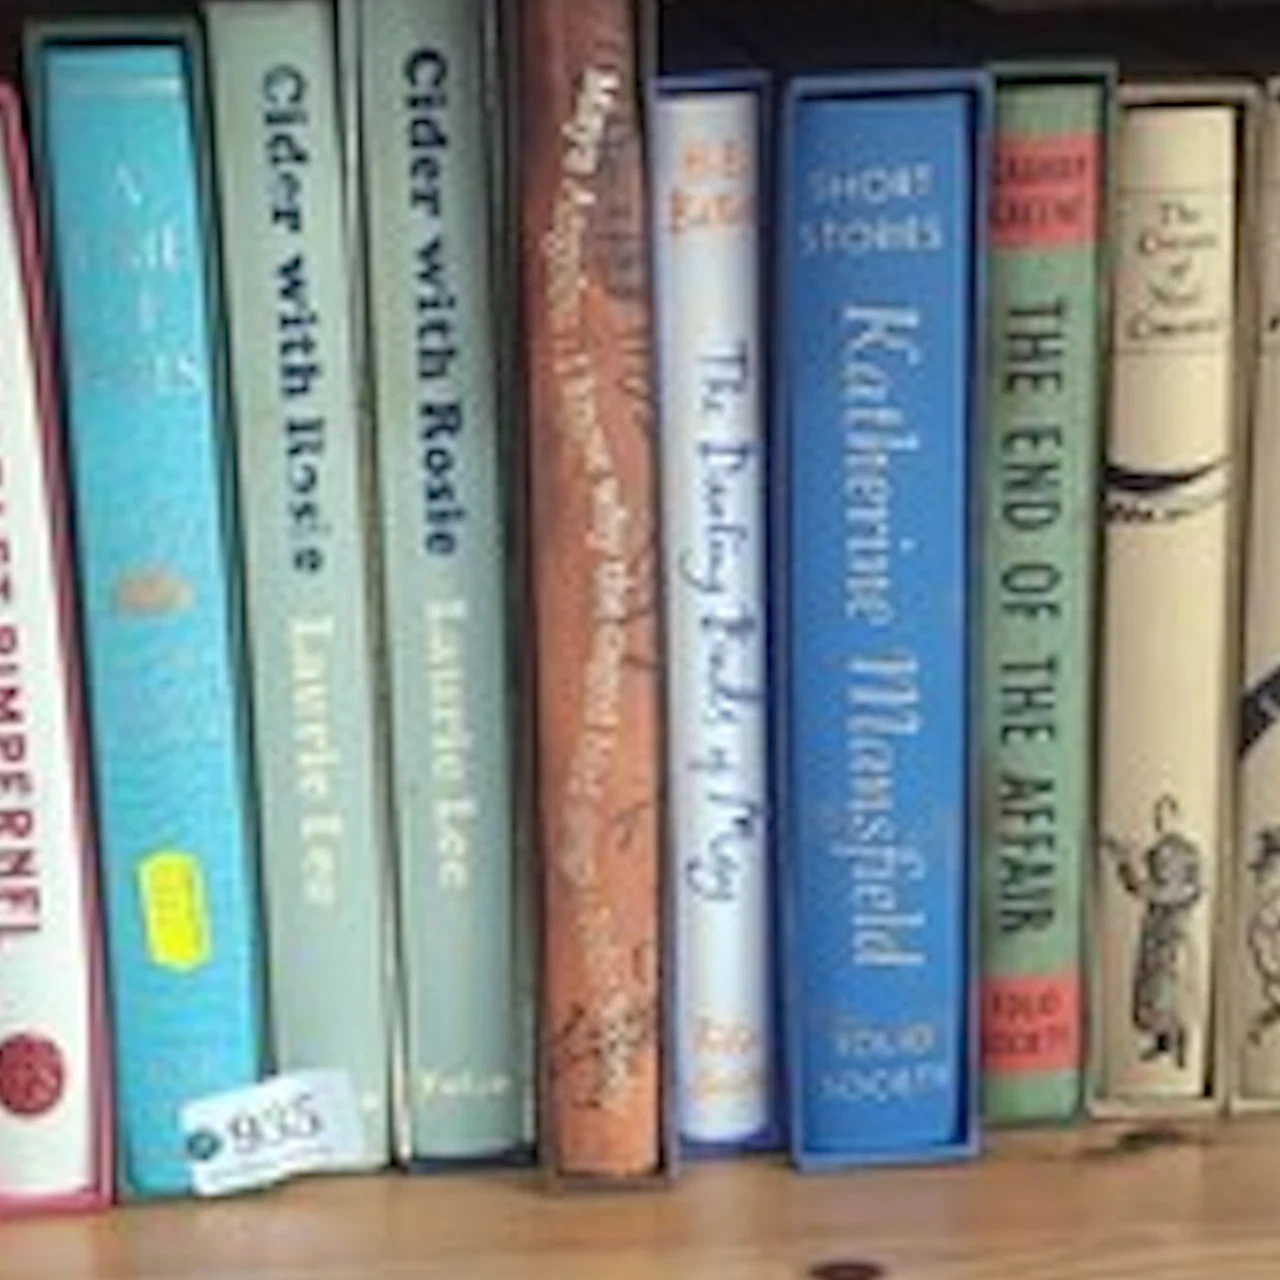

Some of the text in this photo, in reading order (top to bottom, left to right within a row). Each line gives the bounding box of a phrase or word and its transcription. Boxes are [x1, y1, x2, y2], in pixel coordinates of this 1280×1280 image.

[264, 63, 307, 232] Cider
[800, 217, 943, 256] STORIES
[811, 164, 933, 204] SHORT
[276, 256, 317, 396] with
[403, 50, 467, 557] Cider with Rosie
[698, 340, 749, 414] The
[831, 303, 926, 968] Katherine Mansfield
[1000, 298, 1068, 935] THE END OF THE AFFAIR
[290, 614, 344, 908] Laurie Lee
[426, 598, 480, 891] Laurie Lee
